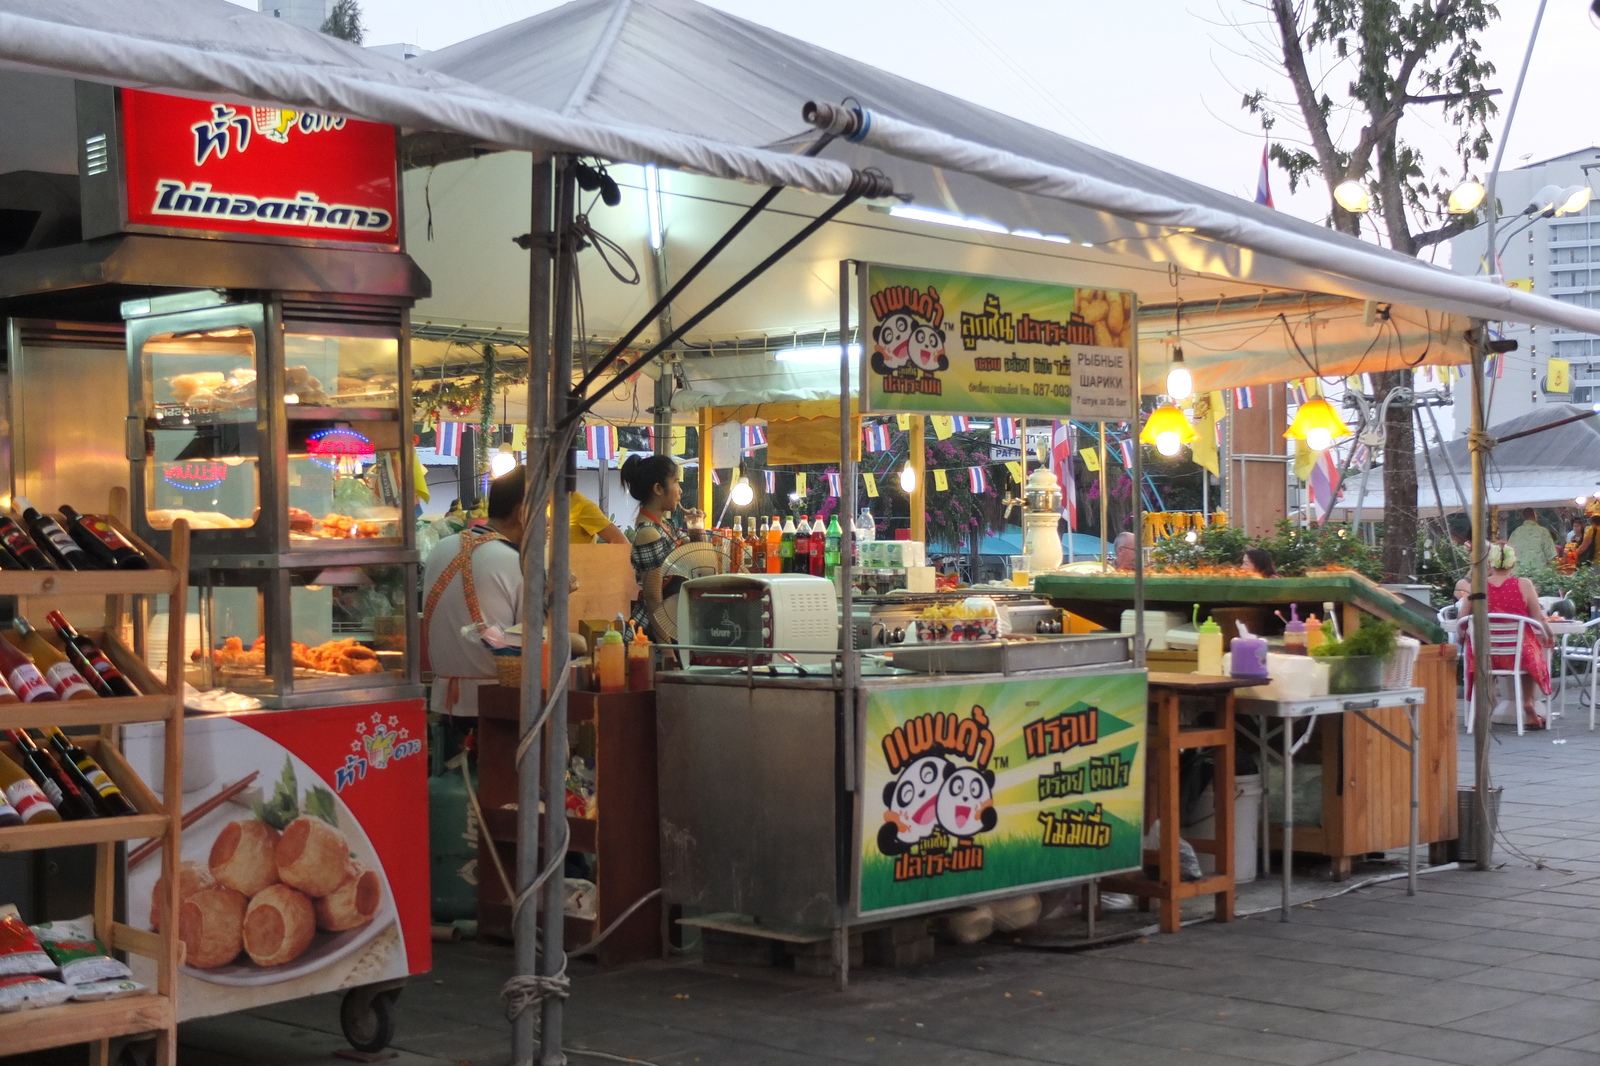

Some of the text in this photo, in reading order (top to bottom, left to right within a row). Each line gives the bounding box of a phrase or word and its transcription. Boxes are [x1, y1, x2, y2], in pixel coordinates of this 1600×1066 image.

[152, 178, 392, 232] ไก่ทอดห้าดาว
[944, 322, 955, 331] TM
[961, 293, 1096, 350] ลูกชิ้น ปลาระเบิด
[1078, 353, 1123, 368] РЫБНЫЕ
[1080, 375, 1122, 388] ШАРИКИ
[1033, 383, 1071, 397] 087-003
[1082, 398, 1098, 407] штук
[1116, 398, 1127, 407] бат
[882, 705, 995, 775] แพนด้า
[1023, 706, 1098, 760] กรอบ
[994, 756, 1009, 769] TM
[1038, 753, 1131, 801] อร่อย ติดใจ
[1037, 802, 1112, 848] ไม่มีเบื่อ
[893, 838, 984, 882] ปลาระเบิด
